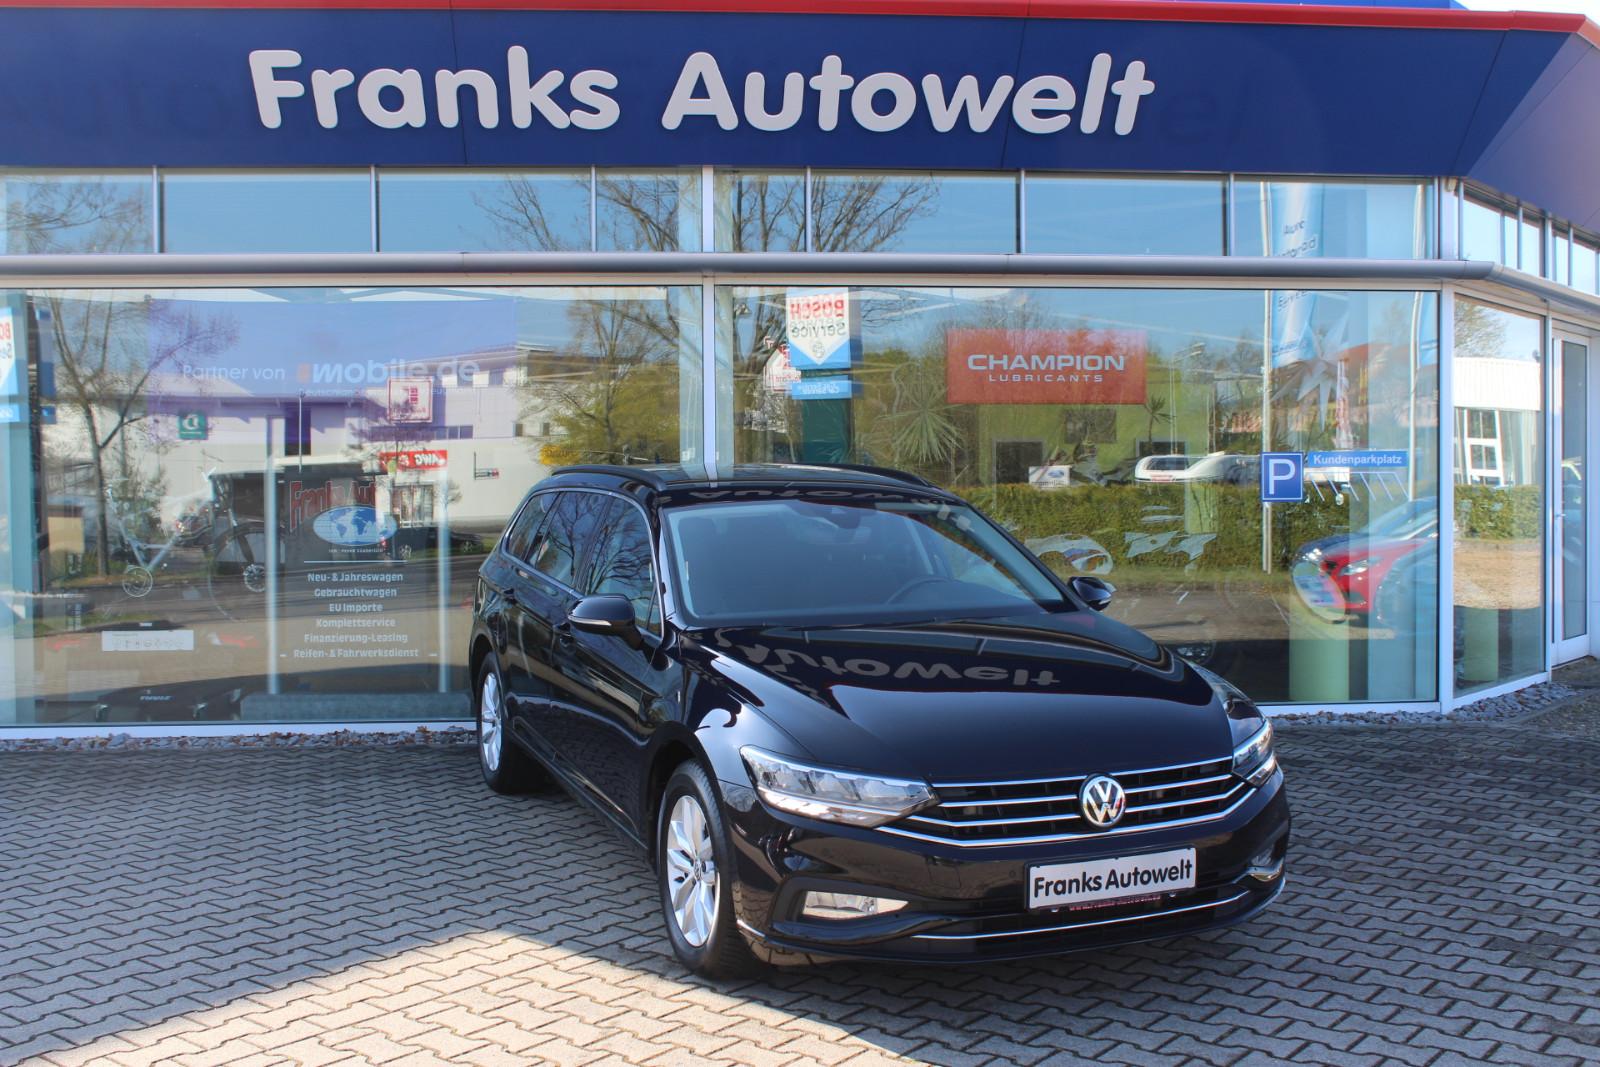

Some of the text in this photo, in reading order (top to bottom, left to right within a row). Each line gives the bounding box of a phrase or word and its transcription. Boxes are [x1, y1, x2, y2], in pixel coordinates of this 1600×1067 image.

[248, 45, 1156, 137] Franks Autowelt
[967, 354, 1125, 371] CHAMPION
[182, 364, 248, 382] Partner
[253, 369, 285, 381] von
[988, 374, 1104, 383] LUBRICANTS
[1312, 453, 1403, 467] Kundenparkplatz
[1268, 458, 1297, 496] P
[314, 588, 397, 598] Gebrauchtwagen
[329, 603, 384, 614] EU Importe
[316, 618, 396, 629] Komplettservice
[1033, 858, 1193, 899] Franks Autowelt
